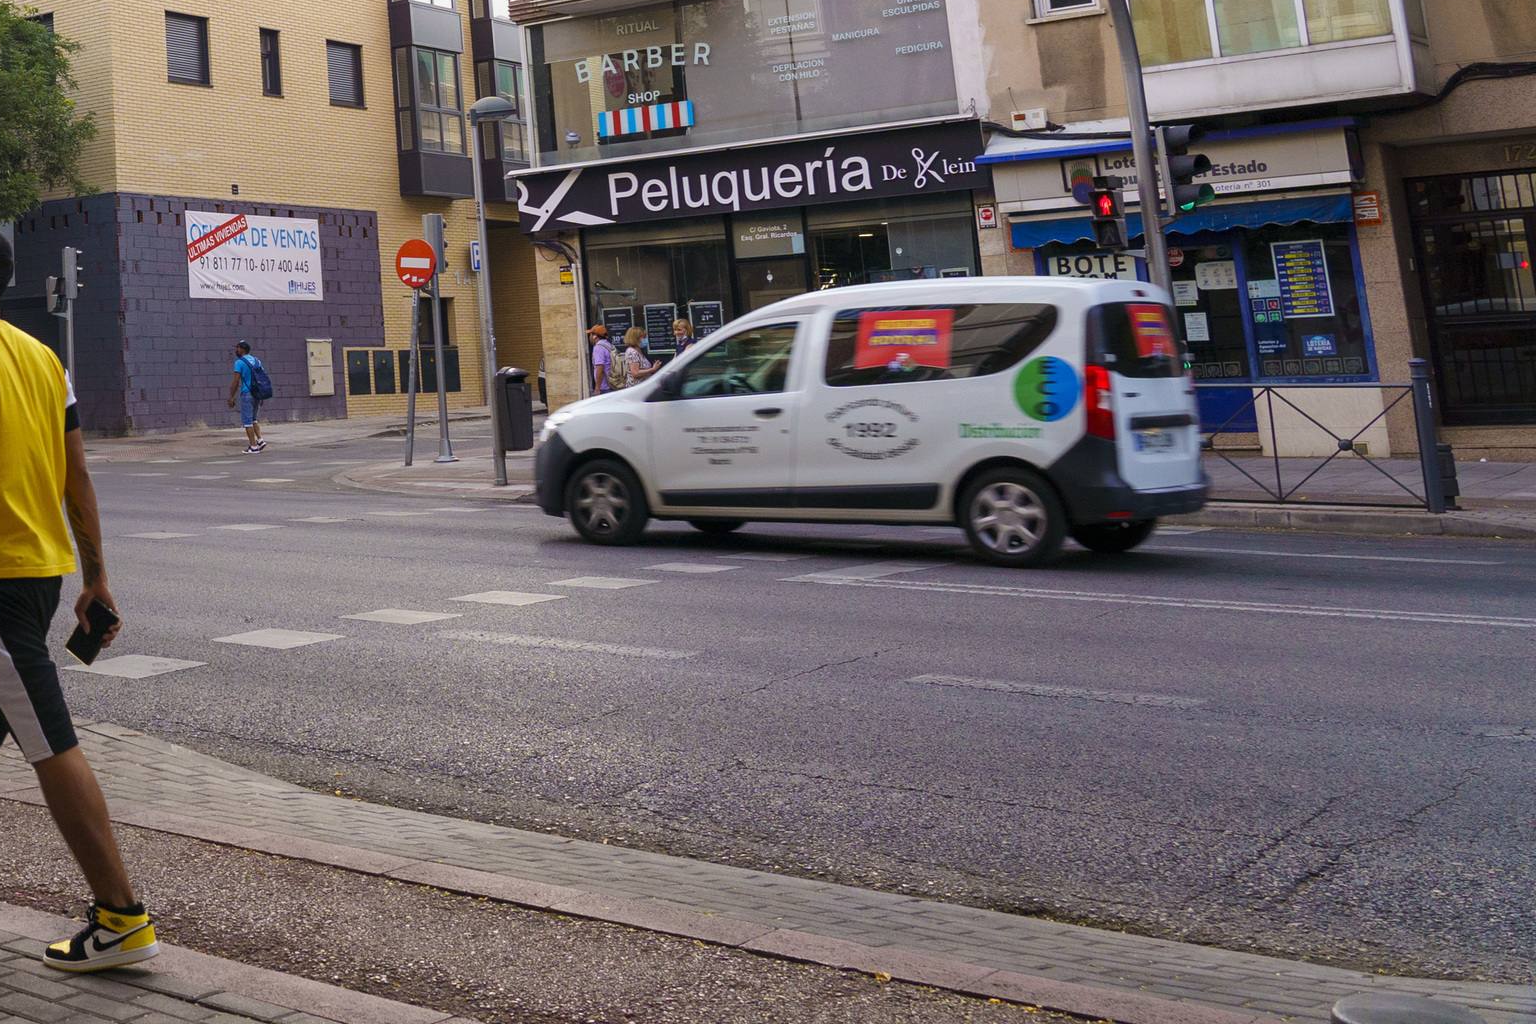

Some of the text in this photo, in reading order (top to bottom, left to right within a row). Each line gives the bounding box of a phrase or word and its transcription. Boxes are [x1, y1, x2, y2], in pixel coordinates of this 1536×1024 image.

[882, 1, 940, 18] ESCULPIDAS
[768, 12, 815, 26] EXTENSION
[616, 20, 659, 35] RITUAL
[771, 21, 815, 35] PESTAÑAS
[832, 27, 880, 42] MANICURA
[895, 41, 943, 55] PEDICURA
[574, 42, 710, 83] BARBER
[772, 58, 824, 73] DEPILACION
[779, 69, 820, 82] CON HILO
[628, 90, 661, 104] SHOP
[1213, 159, 1267, 177] Estado
[607, 146, 873, 216] Peluquería
[881, 164, 907, 181] De
[1214, 182, 1241, 192] otería
[1256, 180, 1271, 188] 301
[740, 234, 754, 242] Esq.
[770, 231, 798, 239] Ricardos
[757, 225, 782, 233] Gaviota,
[188, 217, 247, 258] ULTIMAS VIVIENDAS
[251, 227, 268, 247] DE
[271, 229, 318, 249] VENTAS
[200, 256, 210, 269] 91
[213, 257, 228, 270] 811
[231, 258, 242, 271] 77
[260, 259, 275, 272] 617
[277, 260, 293, 272] 400
[294, 260, 309, 273] 445
[1057, 254, 1127, 275] BOTE
[296, 281, 316, 291] HIJES
[1032, 360, 1061, 417] ECO
[842, 422, 898, 438] 1992
